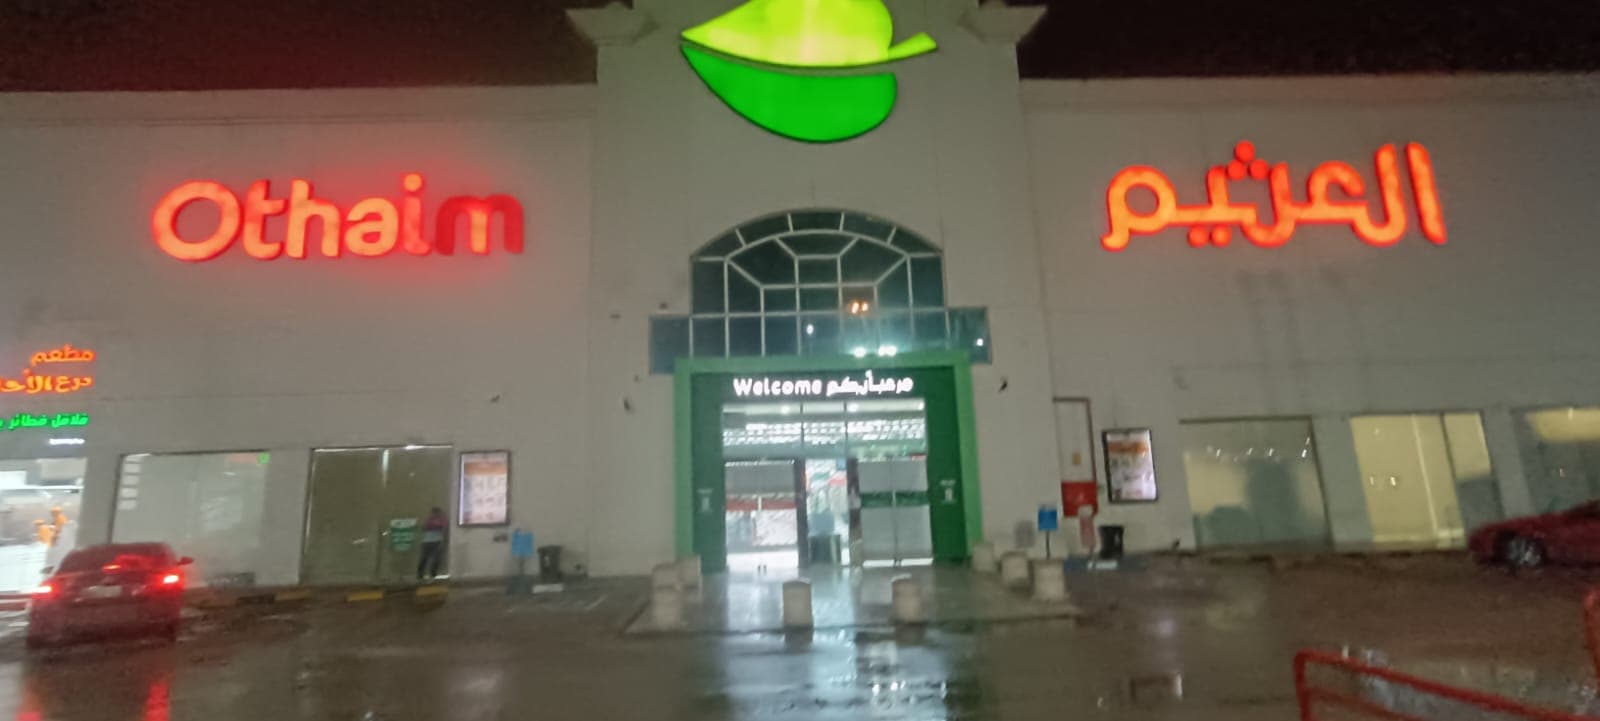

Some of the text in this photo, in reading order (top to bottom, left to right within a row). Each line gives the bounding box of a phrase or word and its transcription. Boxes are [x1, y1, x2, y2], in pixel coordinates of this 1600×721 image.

[152, 173, 524, 261] Othaim
[1100, 140, 1447, 251] العثيم
[31, 344, 96, 366] مطعم
[733, 378, 822, 396] Welcome
